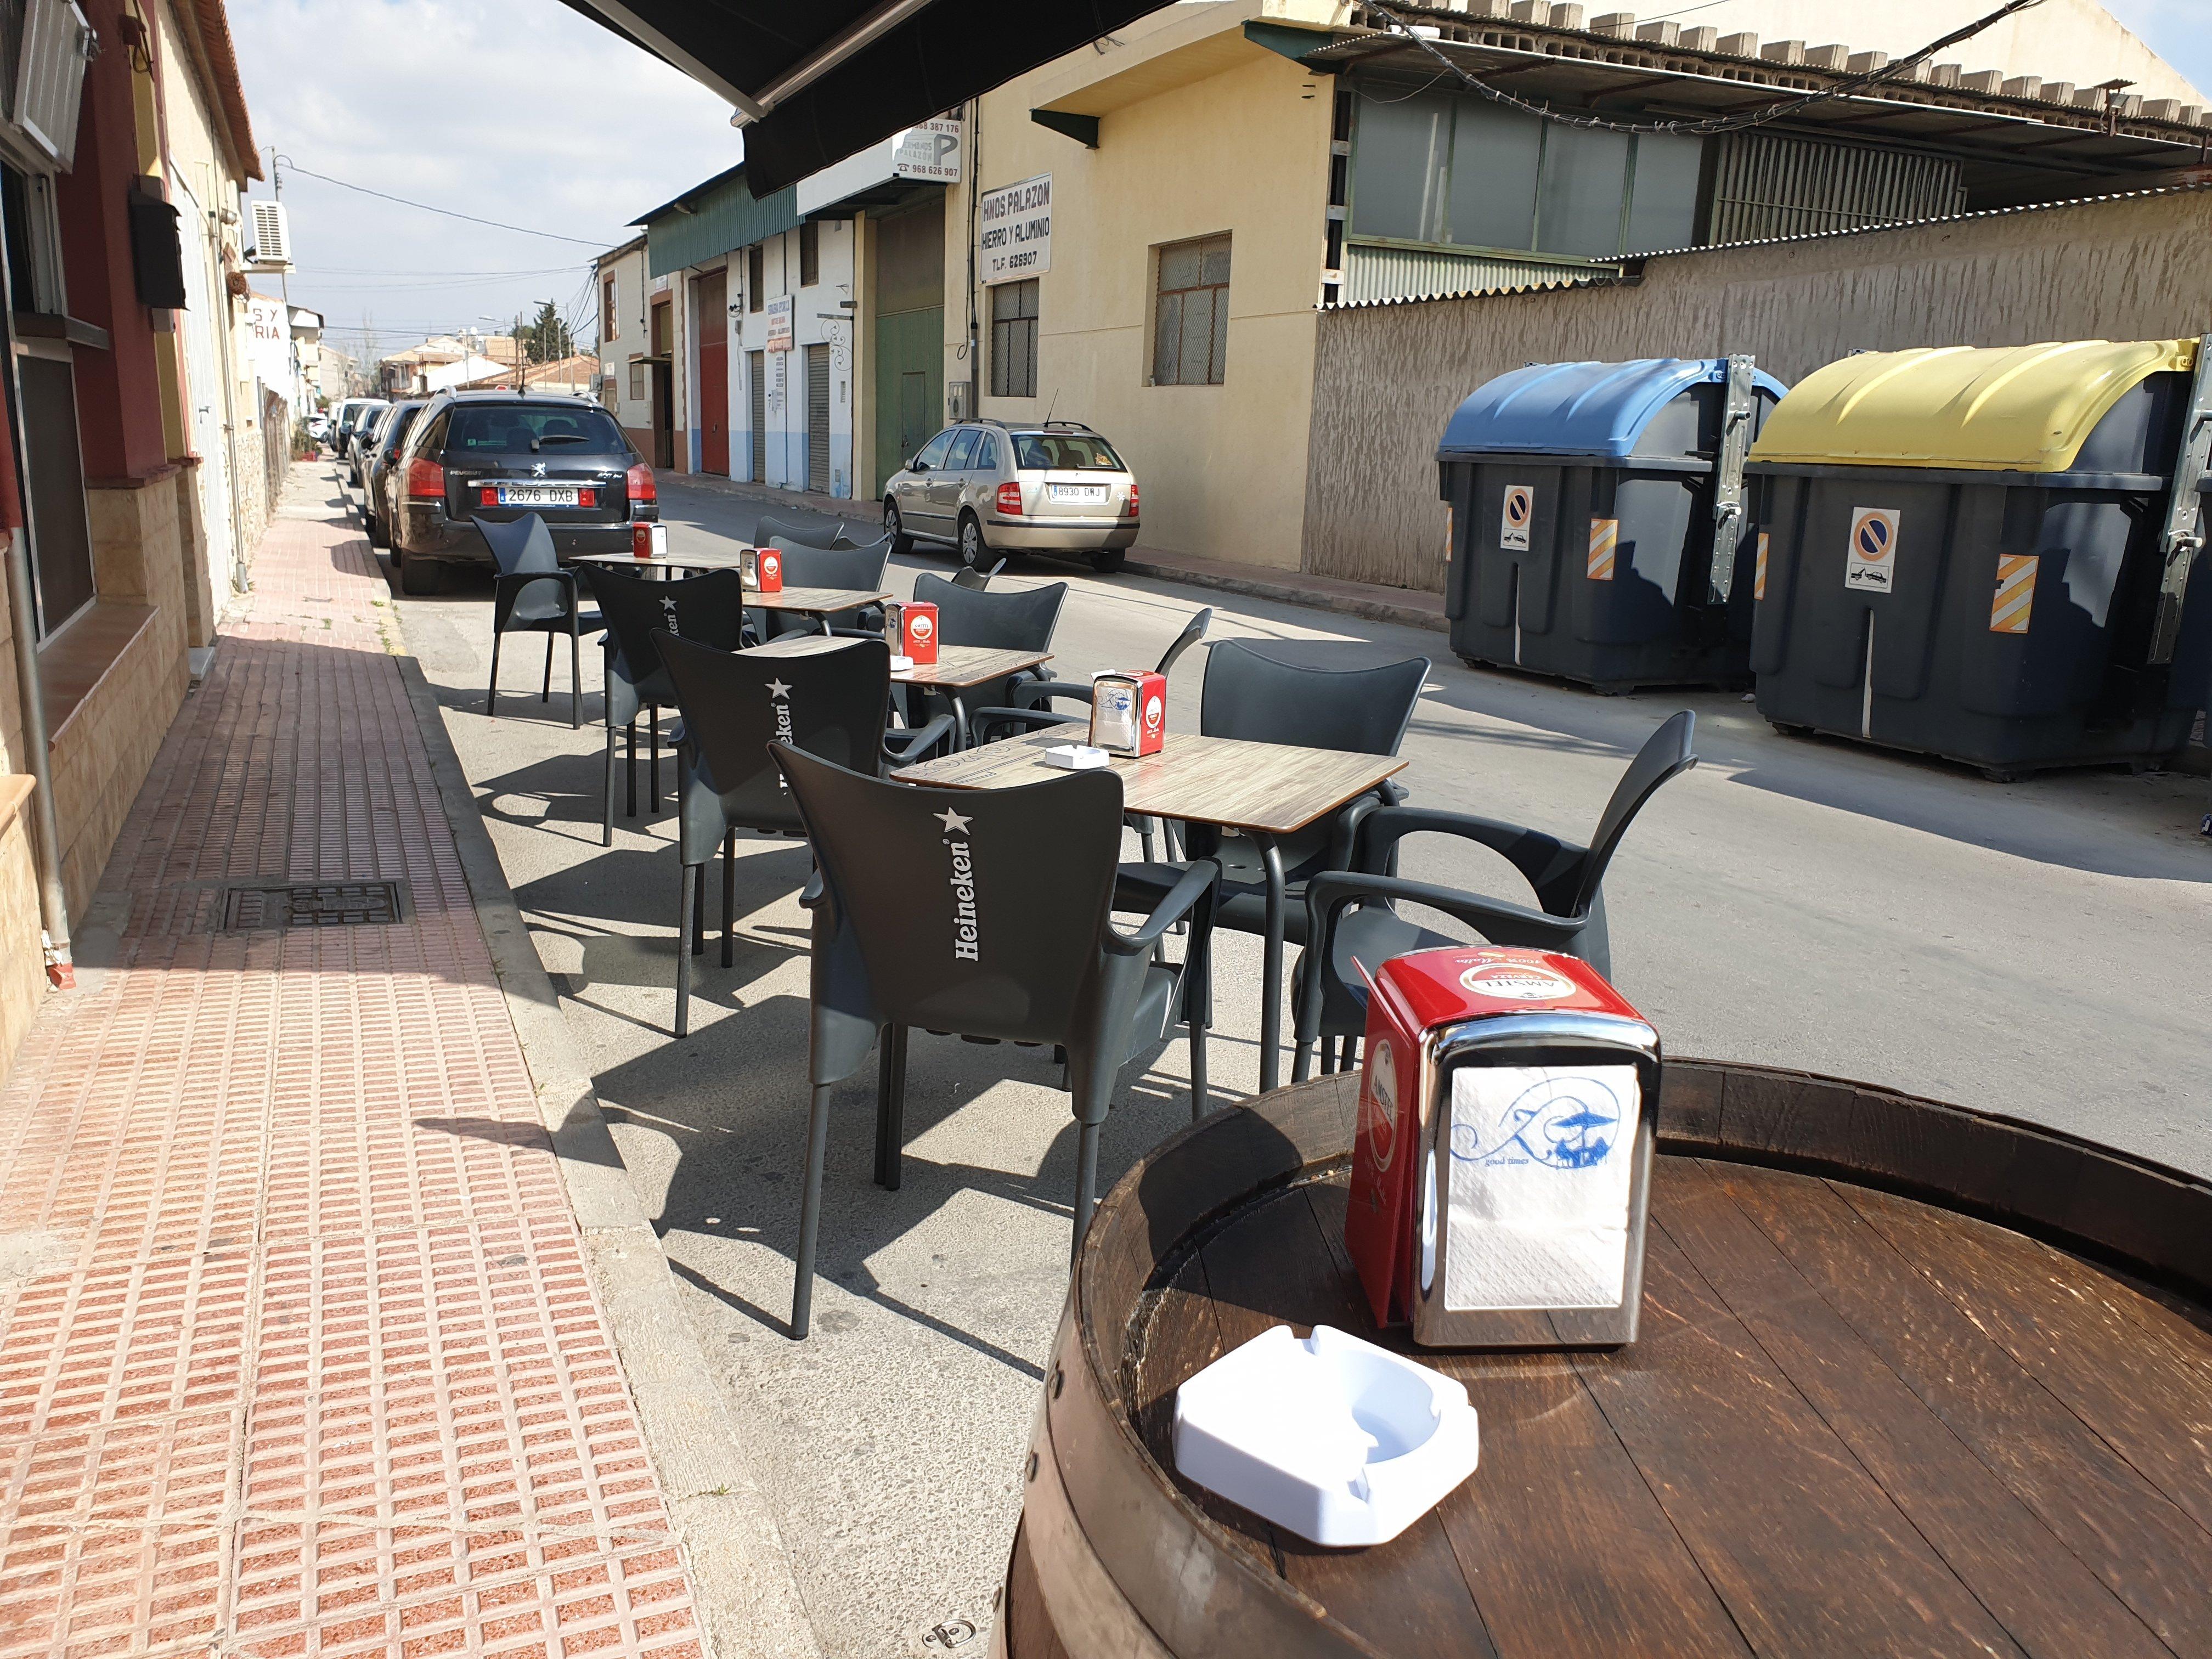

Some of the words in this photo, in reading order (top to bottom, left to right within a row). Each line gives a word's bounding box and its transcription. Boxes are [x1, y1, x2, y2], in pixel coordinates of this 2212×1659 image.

[930, 122, 943, 131] 387
[946, 124, 959, 133] 176
[934, 134, 958, 165] P
[912, 165, 926, 173] 968
[928, 167, 942, 175] 626
[944, 168, 958, 177] 907
[981, 227, 1007, 250] HIERRO
[1009, 225, 1014, 245] Y
[1015, 217, 1049, 244] ALUMINIO
[992, 257, 1007, 272] TLF.
[1009, 251, 1037, 269] 626907
[270, 309, 278, 322] Y
[509, 489, 541, 501] 2676
[550, 489, 573, 502] DXB
[1058, 487, 1079, 496] 8930
[950, 842, 978, 961] Heineken
[1373, 1075, 1393, 1122] AMSTEL
[1485, 1156, 1505, 1167] good
[1508, 1156, 1529, 1165] times
